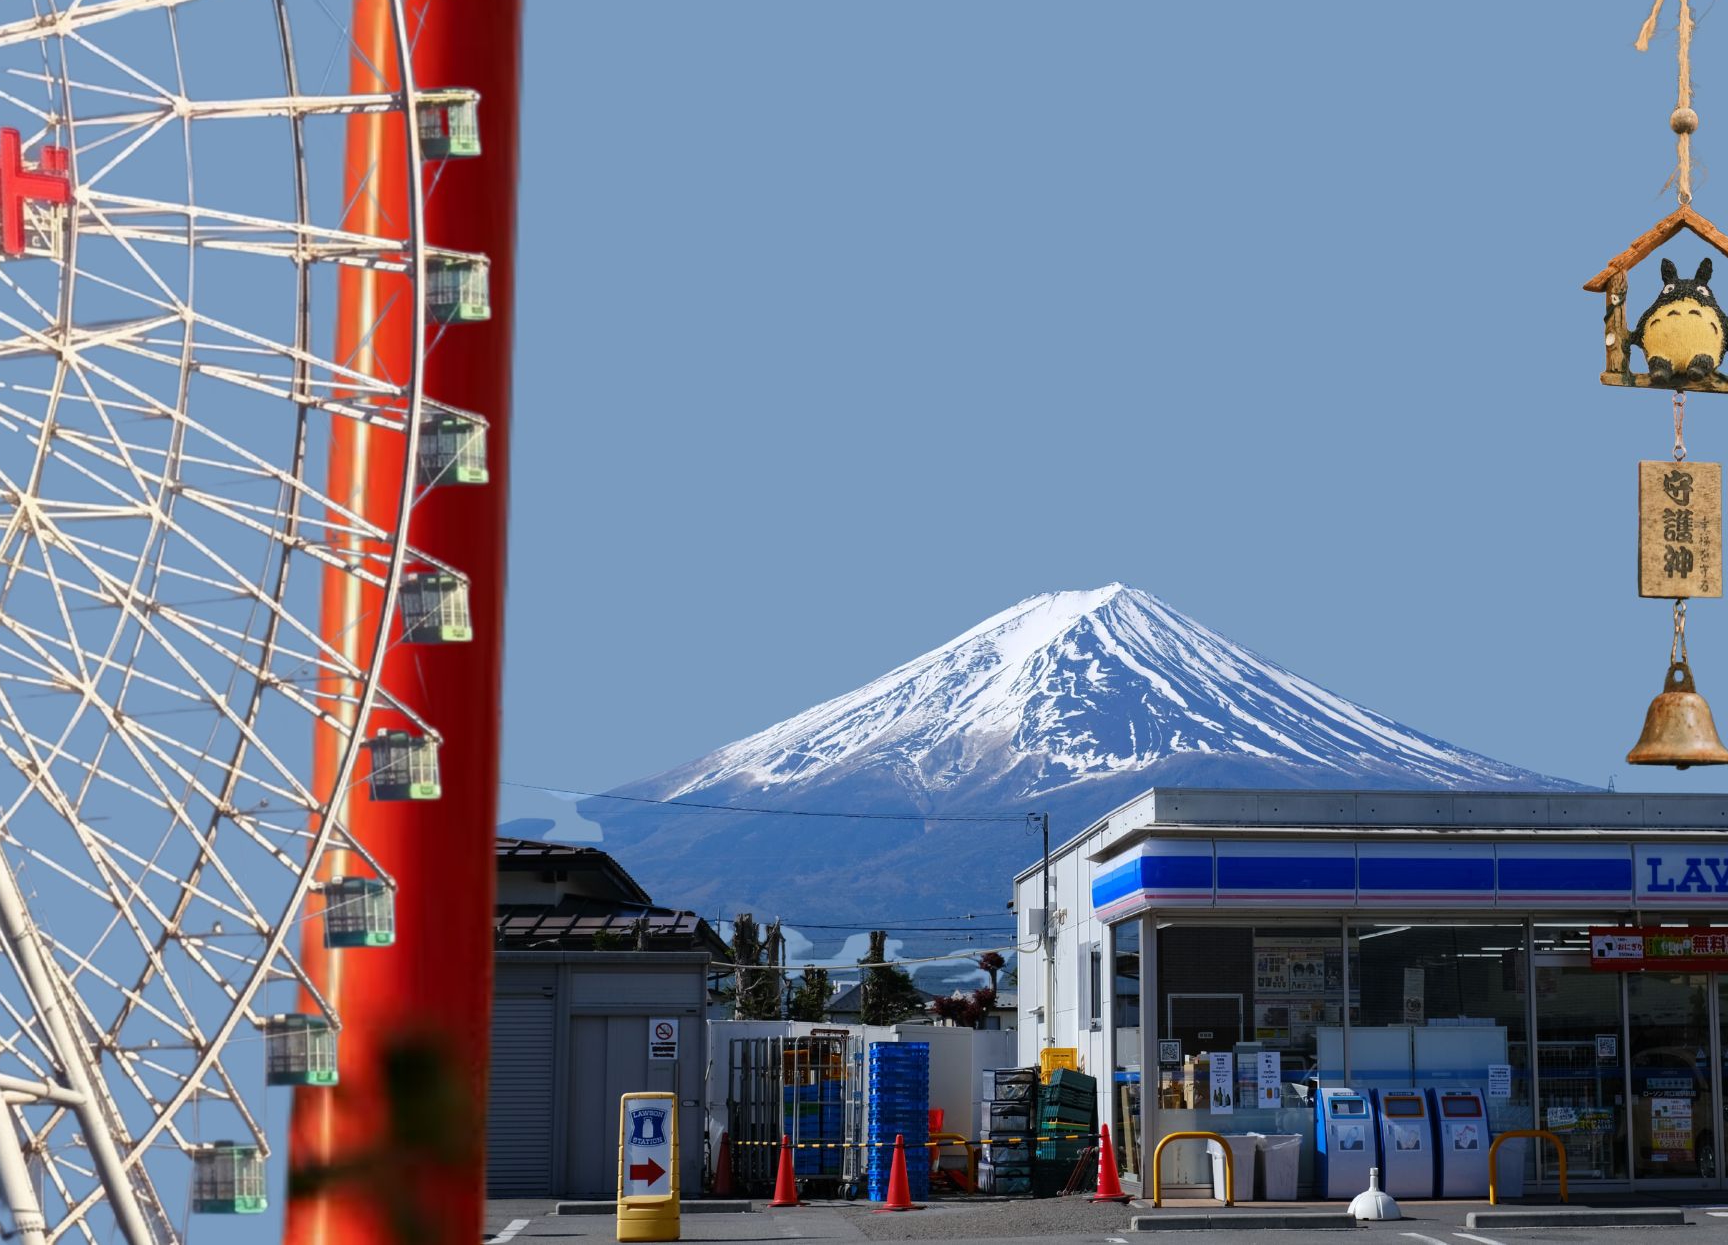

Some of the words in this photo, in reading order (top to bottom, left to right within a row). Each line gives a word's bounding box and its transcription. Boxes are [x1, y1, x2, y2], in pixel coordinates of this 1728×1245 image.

[1663, 470, 1694, 579] 守護神
[633, 1110, 663, 1119] LAWSON
[633, 1137, 663, 1145] STATION
